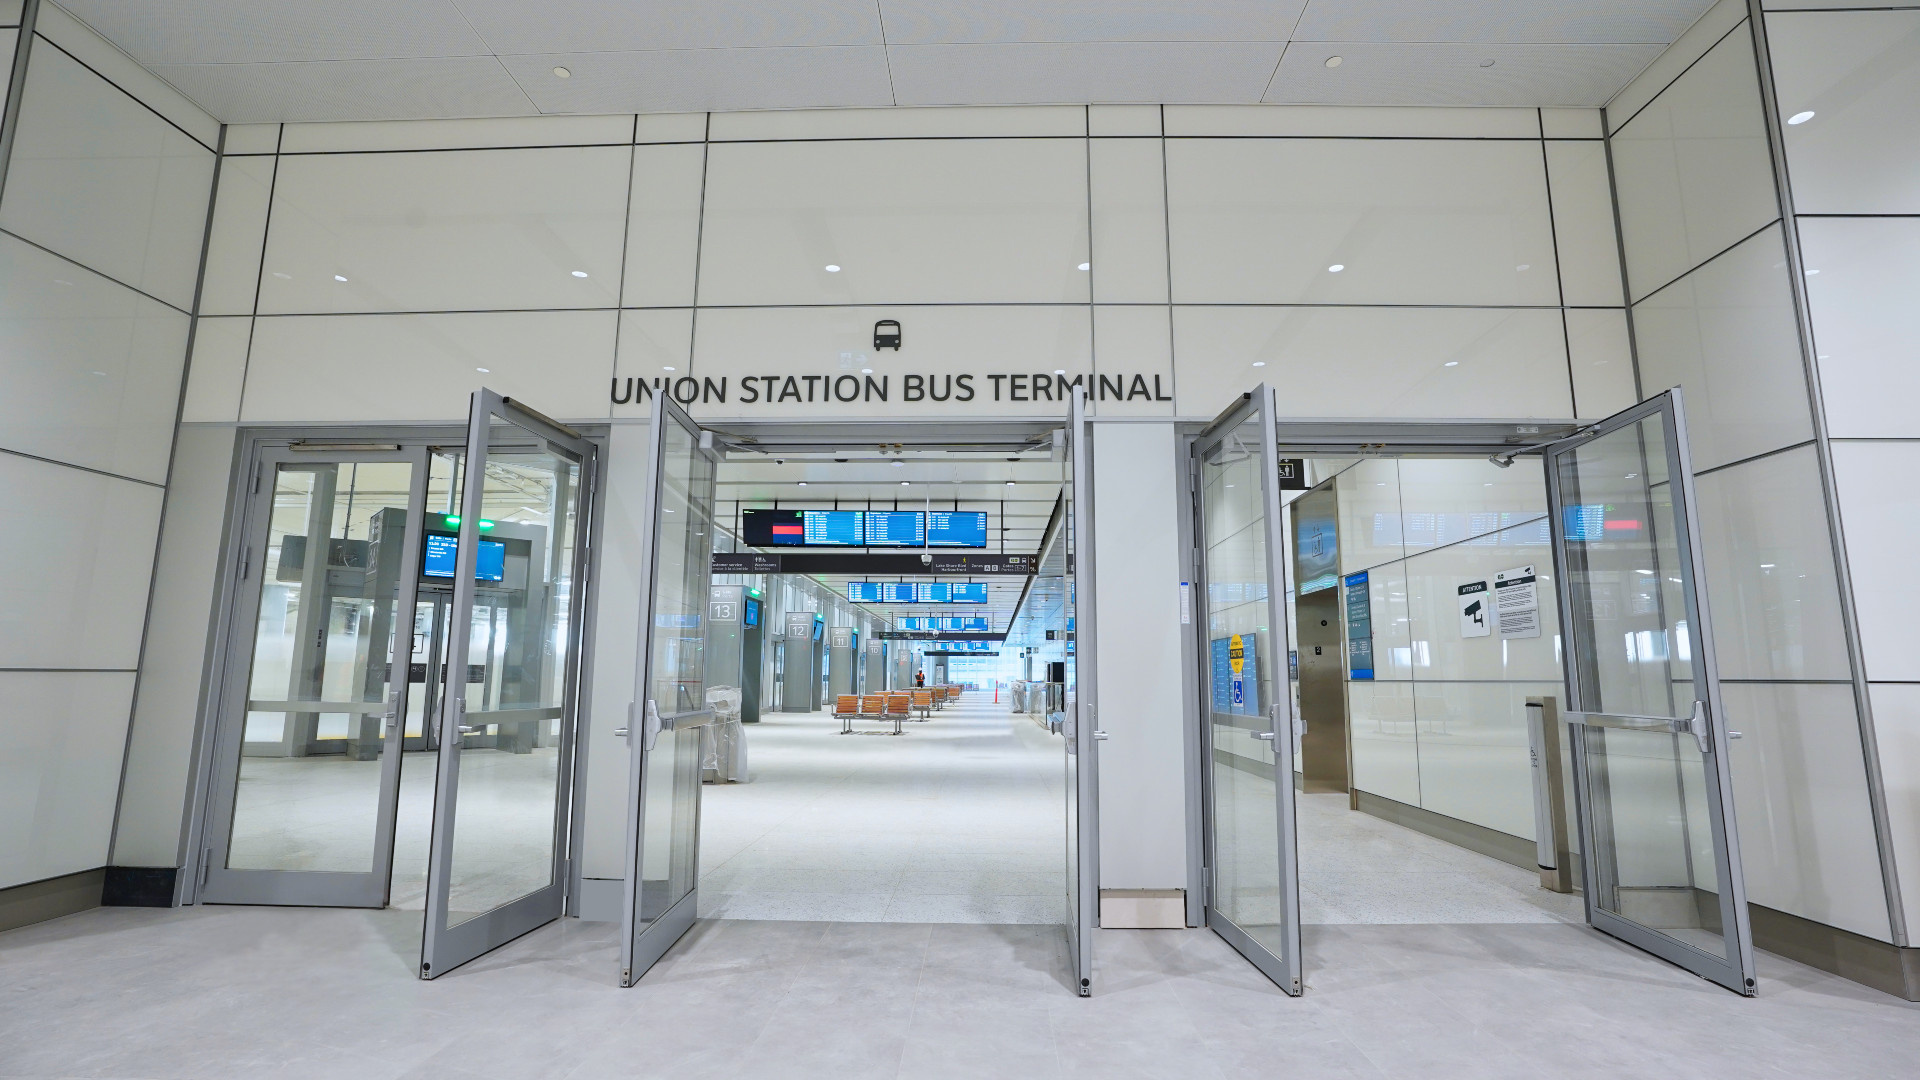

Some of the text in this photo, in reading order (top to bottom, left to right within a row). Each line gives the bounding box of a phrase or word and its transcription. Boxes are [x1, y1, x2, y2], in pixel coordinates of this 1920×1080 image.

[611, 374, 1173, 404] UNION STATION BUS TERMINAL
[1462, 584, 1482, 593] ATTENTION
[714, 605, 730, 618] 13
[792, 627, 804, 636] 12
